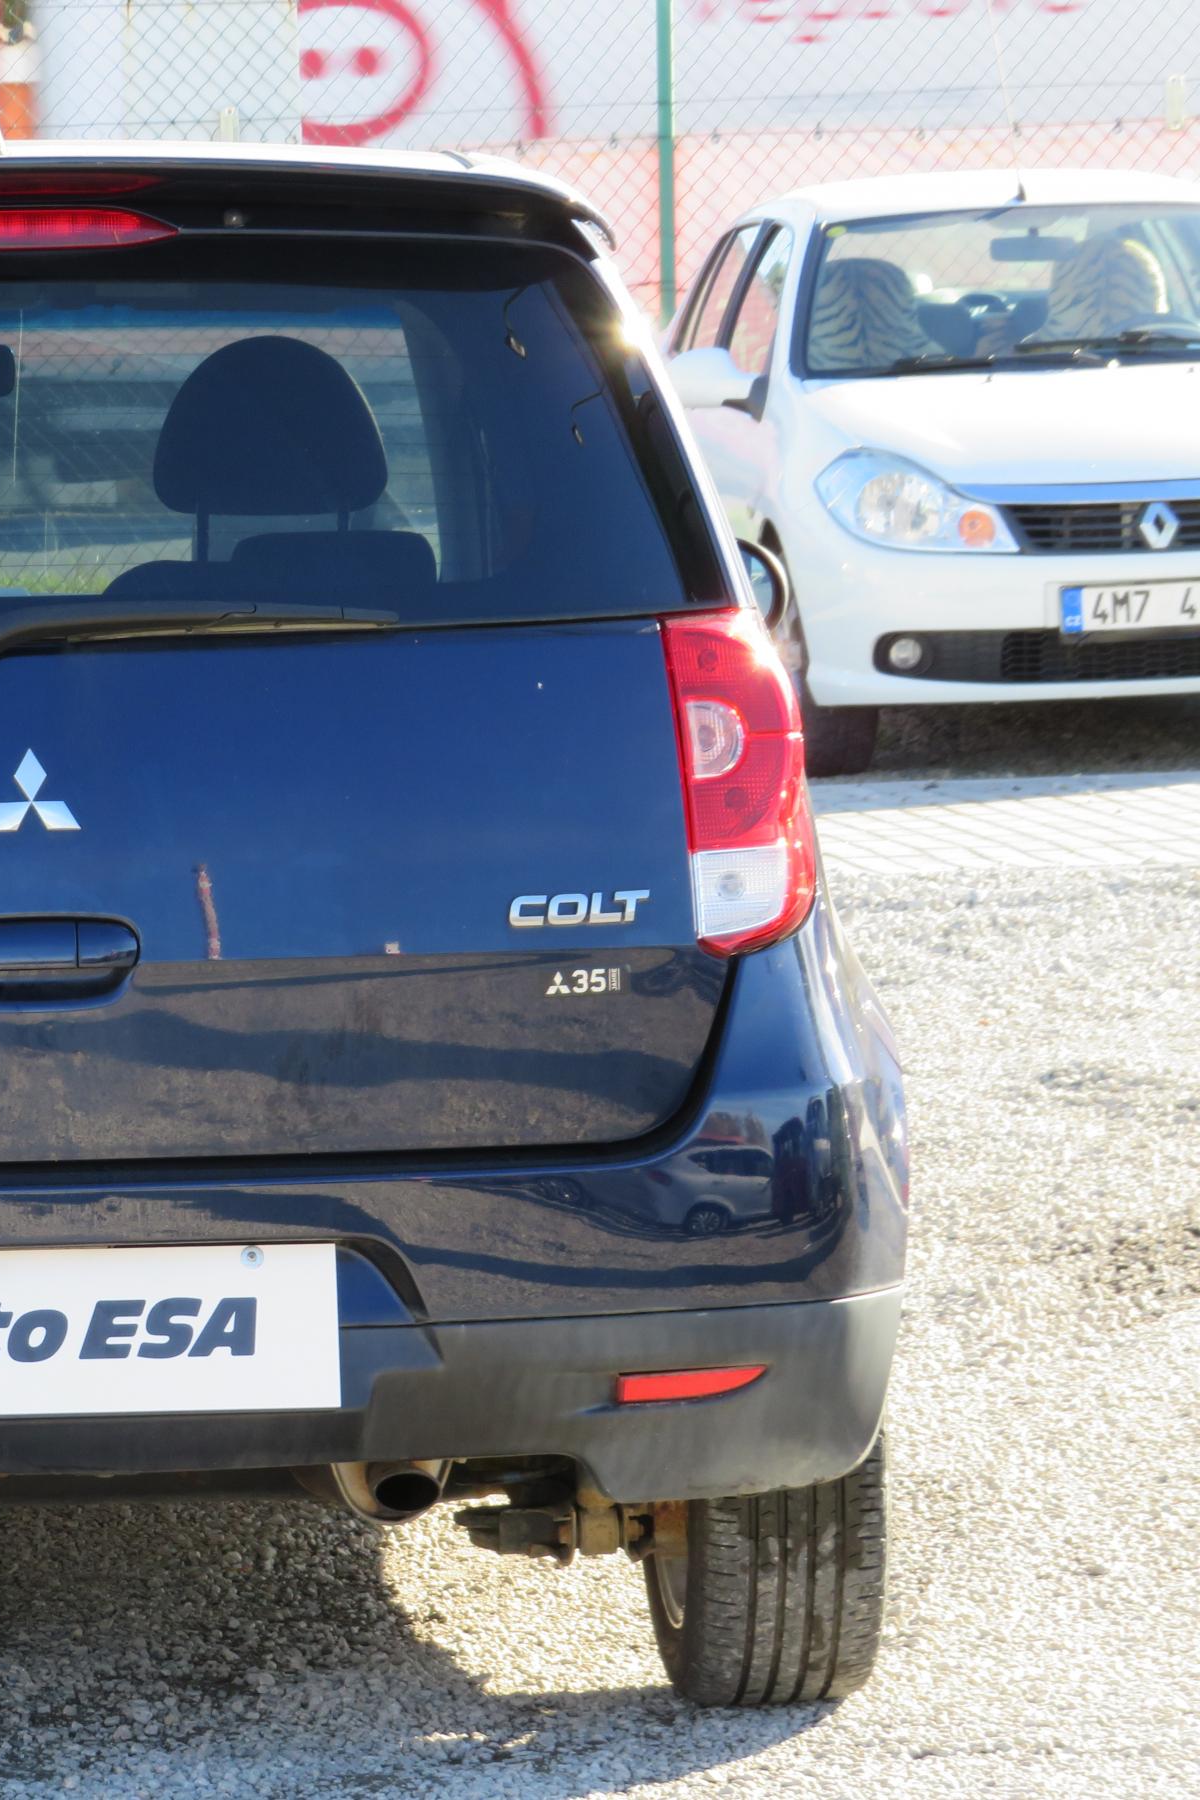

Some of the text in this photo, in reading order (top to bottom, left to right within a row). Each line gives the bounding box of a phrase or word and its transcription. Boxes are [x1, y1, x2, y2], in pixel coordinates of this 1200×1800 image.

[1064, 615, 1081, 627] CZ
[1091, 588, 1197, 625] 4M7 4
[509, 889, 650, 928] COLT
[572, 968, 607, 994] 35
[79, 1297, 257, 1360] ESA
